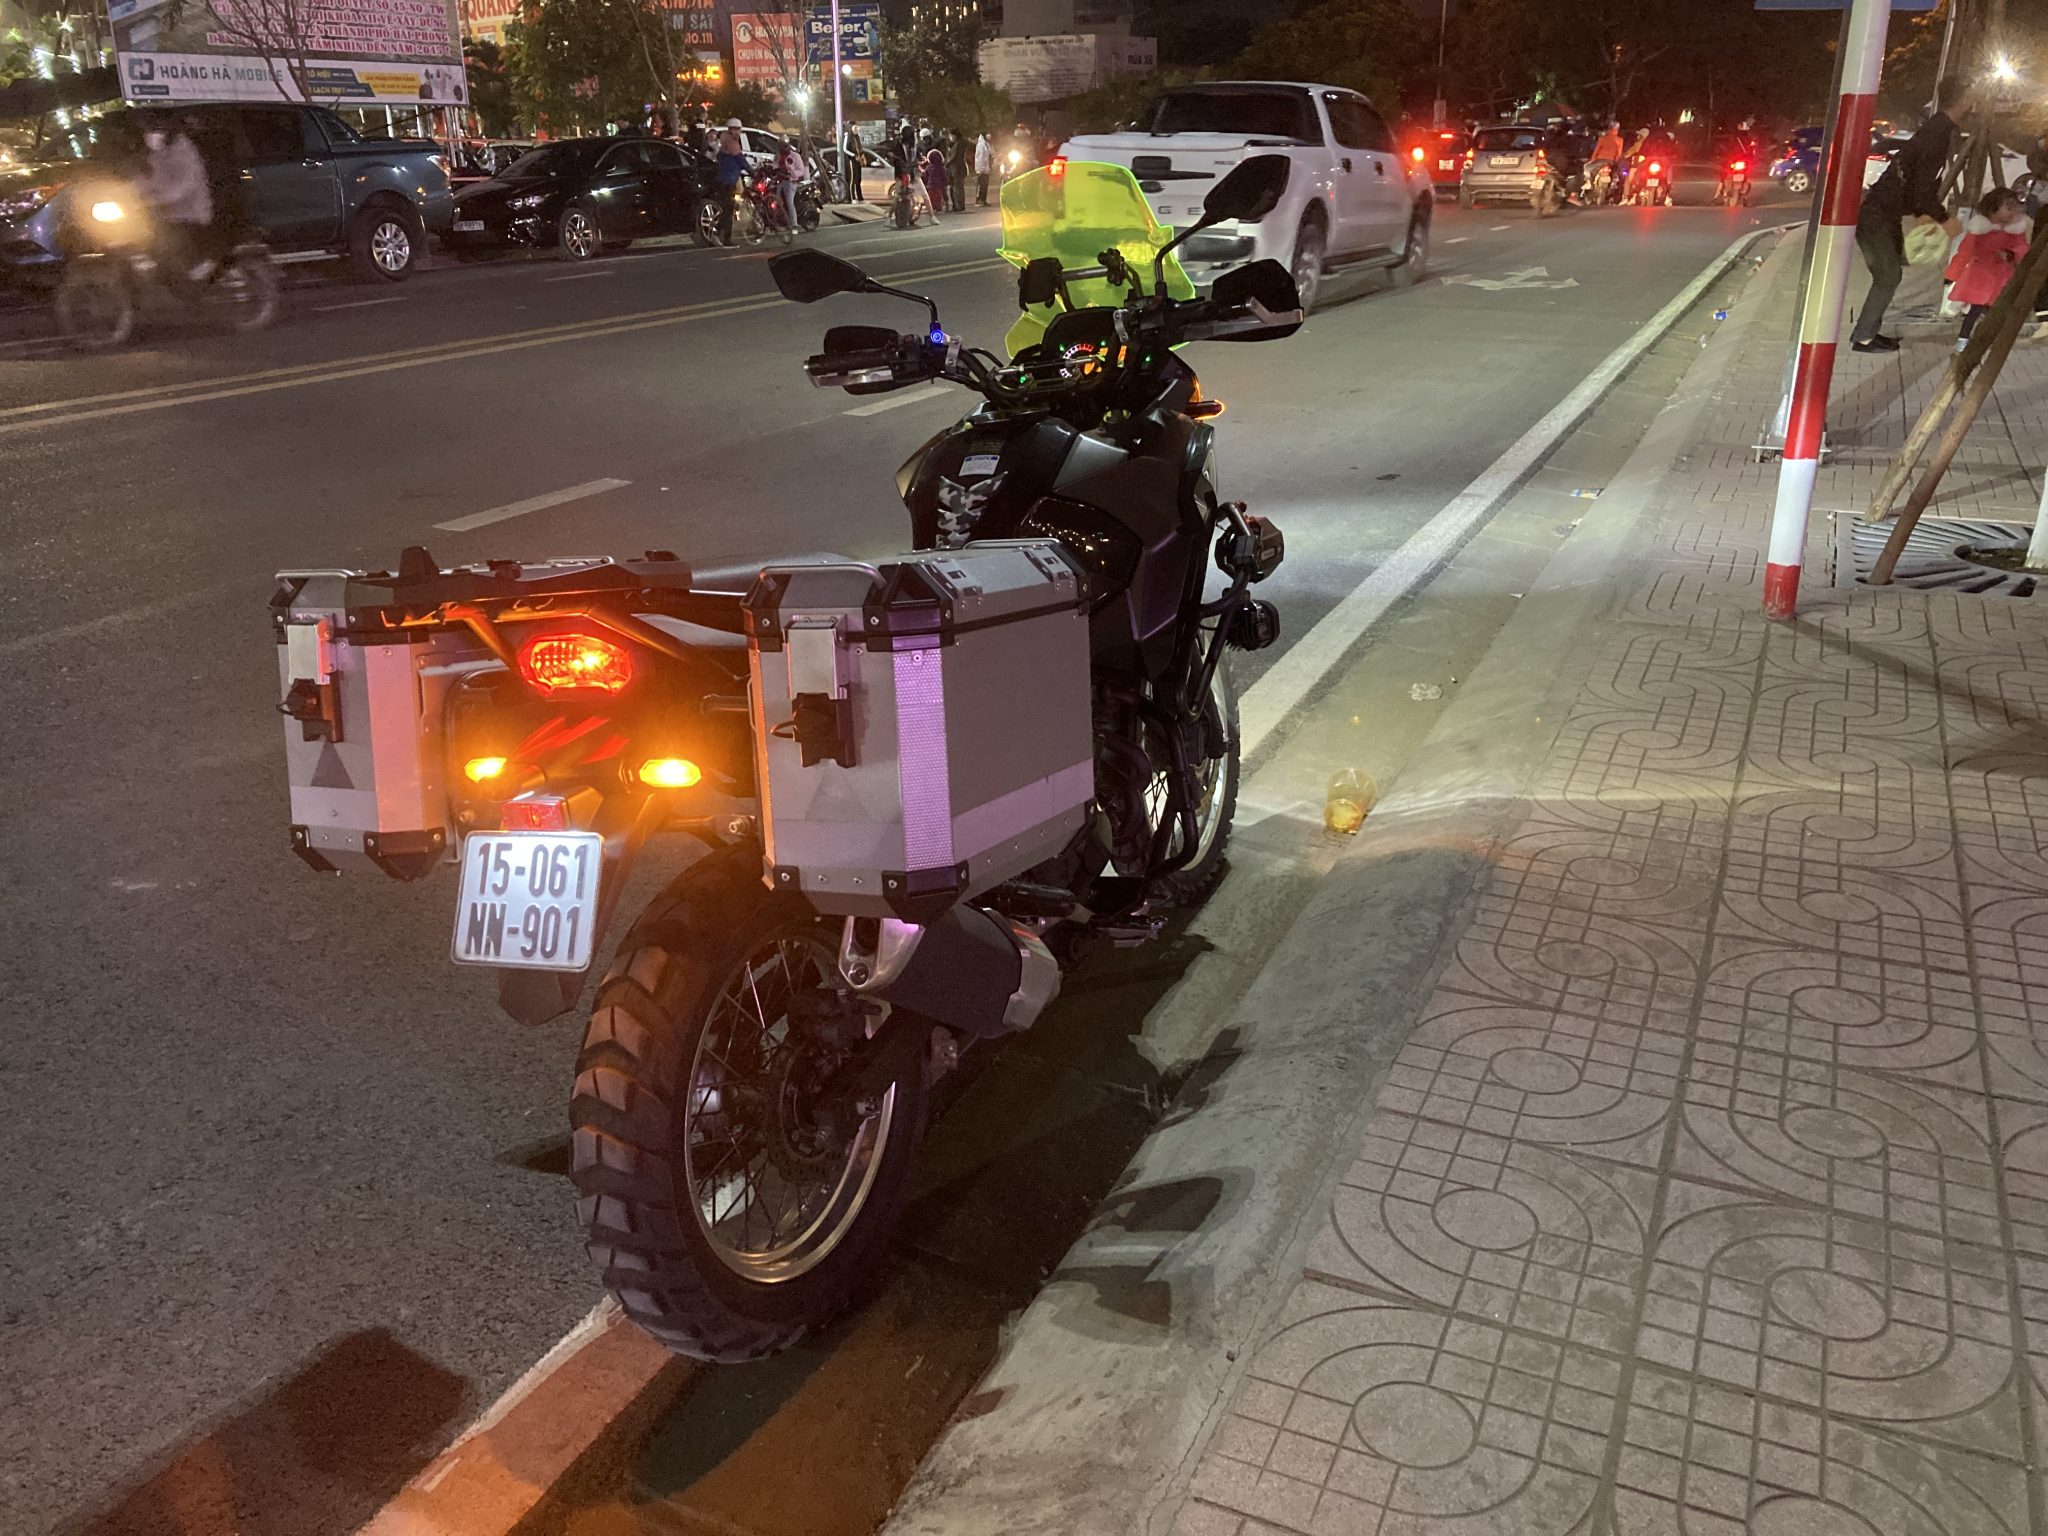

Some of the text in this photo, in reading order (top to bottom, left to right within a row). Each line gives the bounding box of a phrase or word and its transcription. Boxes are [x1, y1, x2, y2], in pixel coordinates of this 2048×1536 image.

[159, 61, 208, 80] HOÀNG
[212, 63, 232, 81] HÀ
[477, 841, 589, 900] 15-061
[464, 901, 582, 962] NN-901
